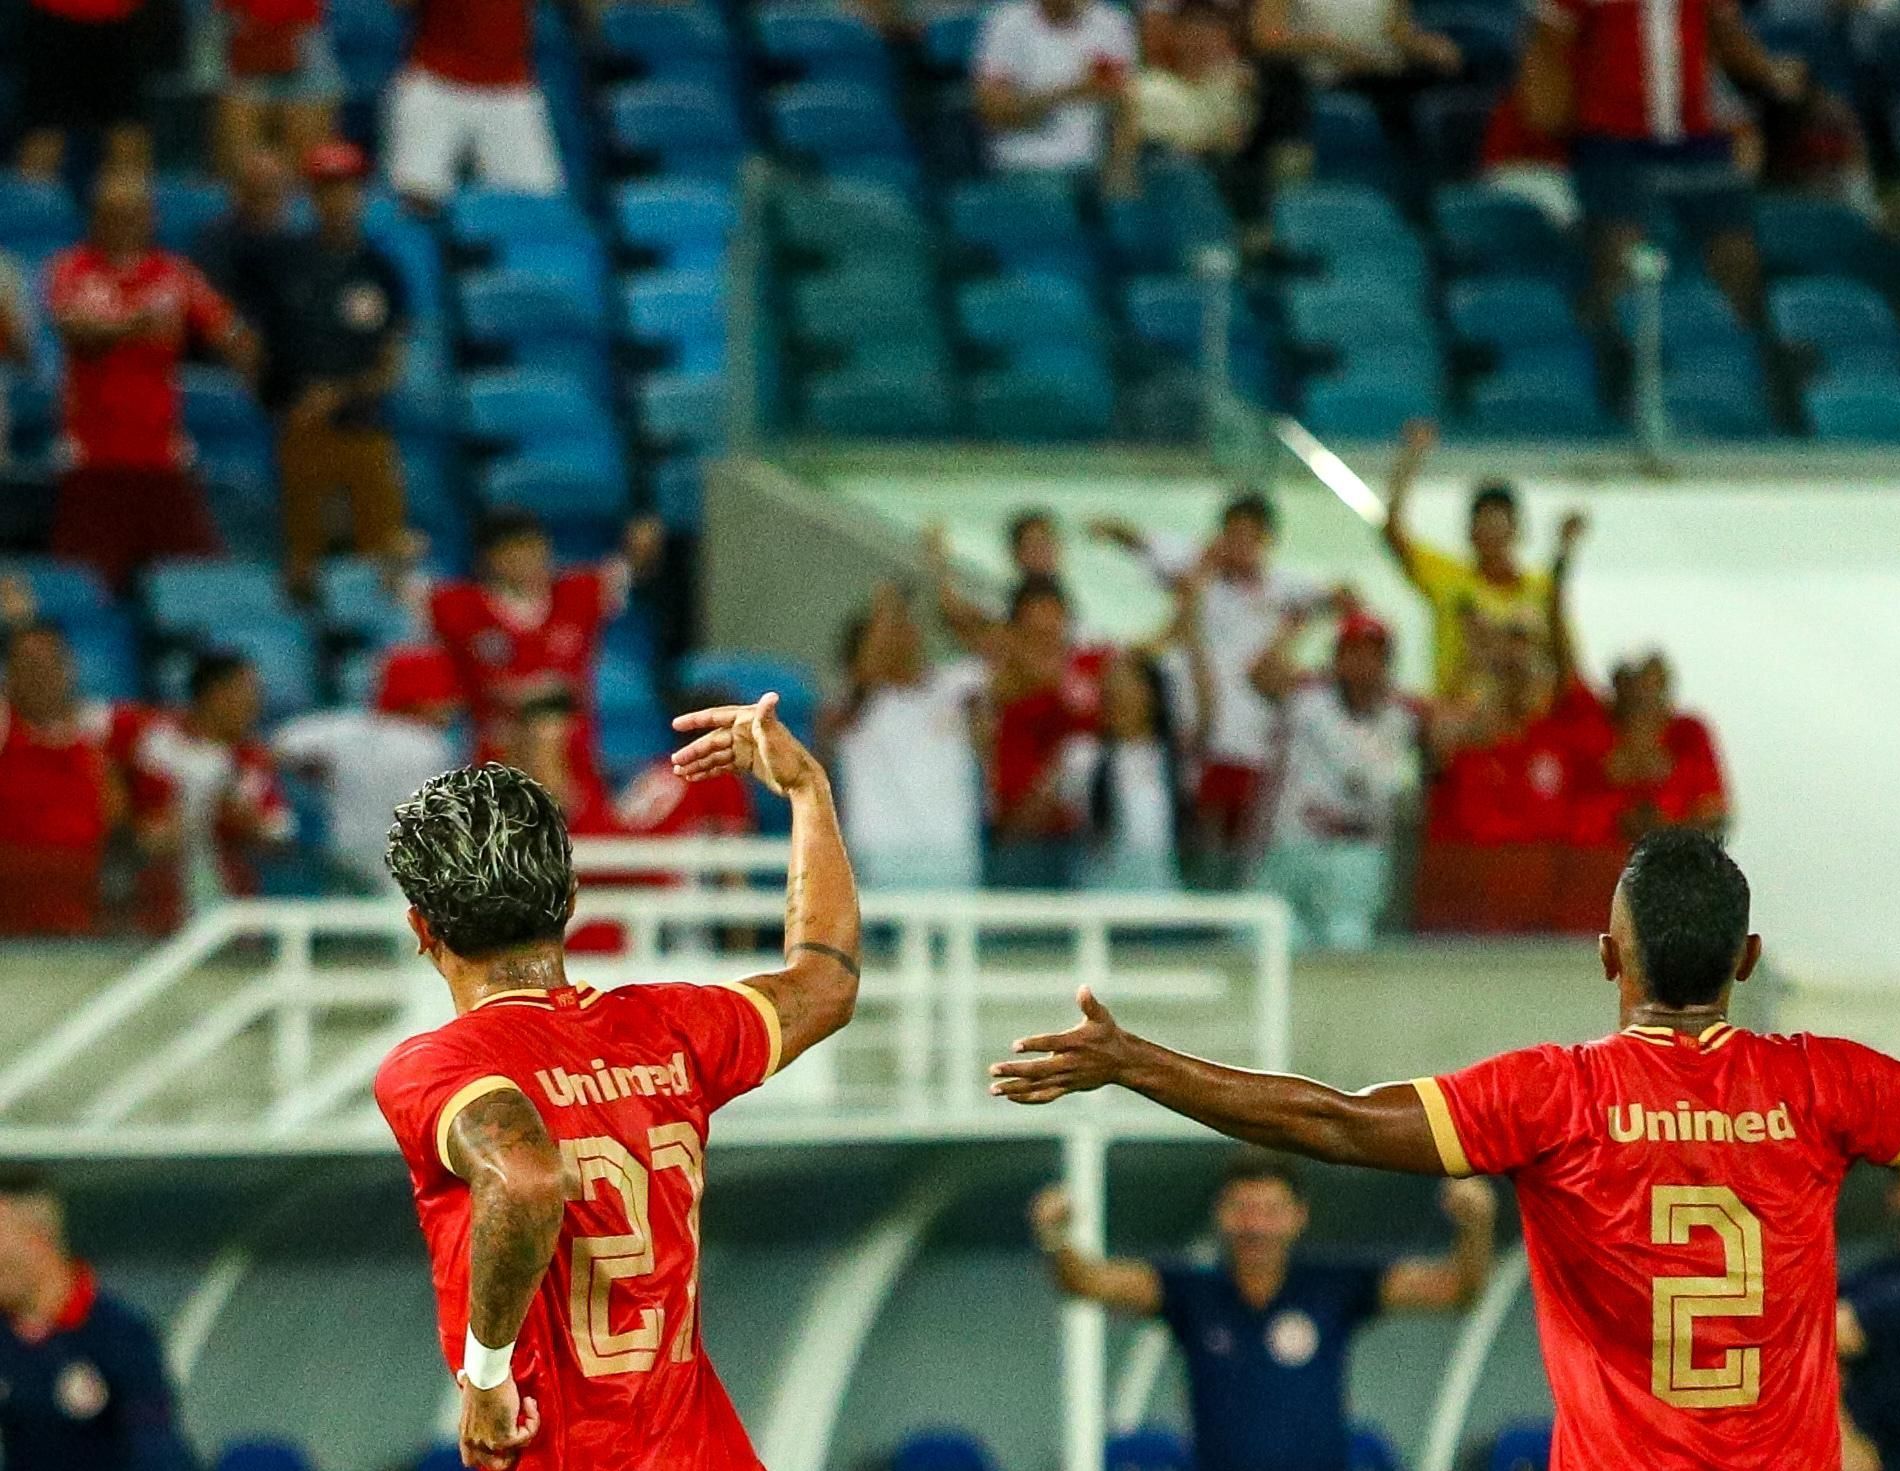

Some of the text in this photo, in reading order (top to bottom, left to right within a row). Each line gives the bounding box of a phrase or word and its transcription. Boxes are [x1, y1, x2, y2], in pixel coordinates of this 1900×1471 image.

[534, 1051, 692, 1108] Unimed
[1607, 1100, 1797, 1144] Unimed
[1651, 1185, 1765, 1409] 2
